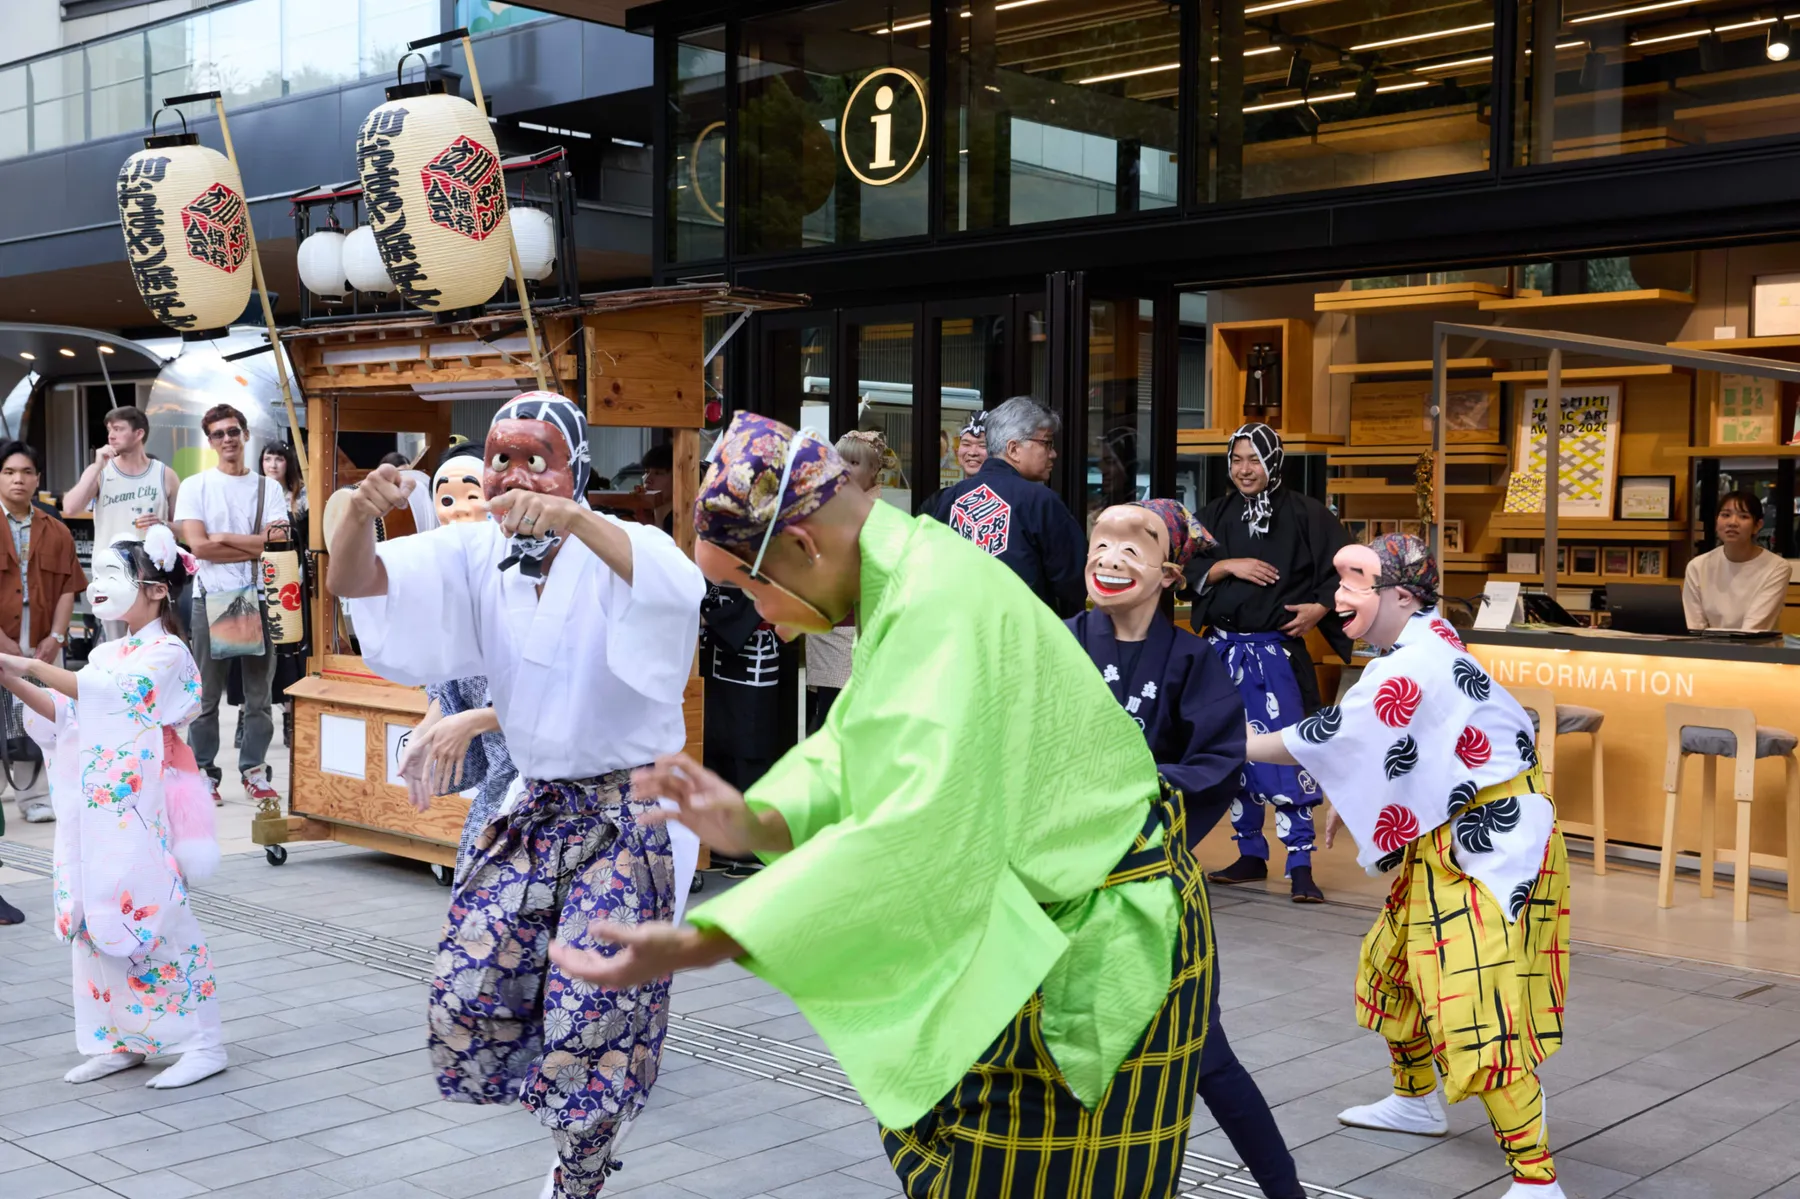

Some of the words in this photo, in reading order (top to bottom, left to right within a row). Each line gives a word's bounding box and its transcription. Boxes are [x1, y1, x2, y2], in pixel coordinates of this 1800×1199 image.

[1532, 411, 1574, 422] PUIC
[1585, 410, 1608, 421] ART
[1531, 424, 1574, 434] AWRD
[102, 491, 136, 507] Cream
[138, 485, 158, 501] City
[978, 514, 1006, 553] おはや
[1490, 659, 1694, 697] INFORMATION
